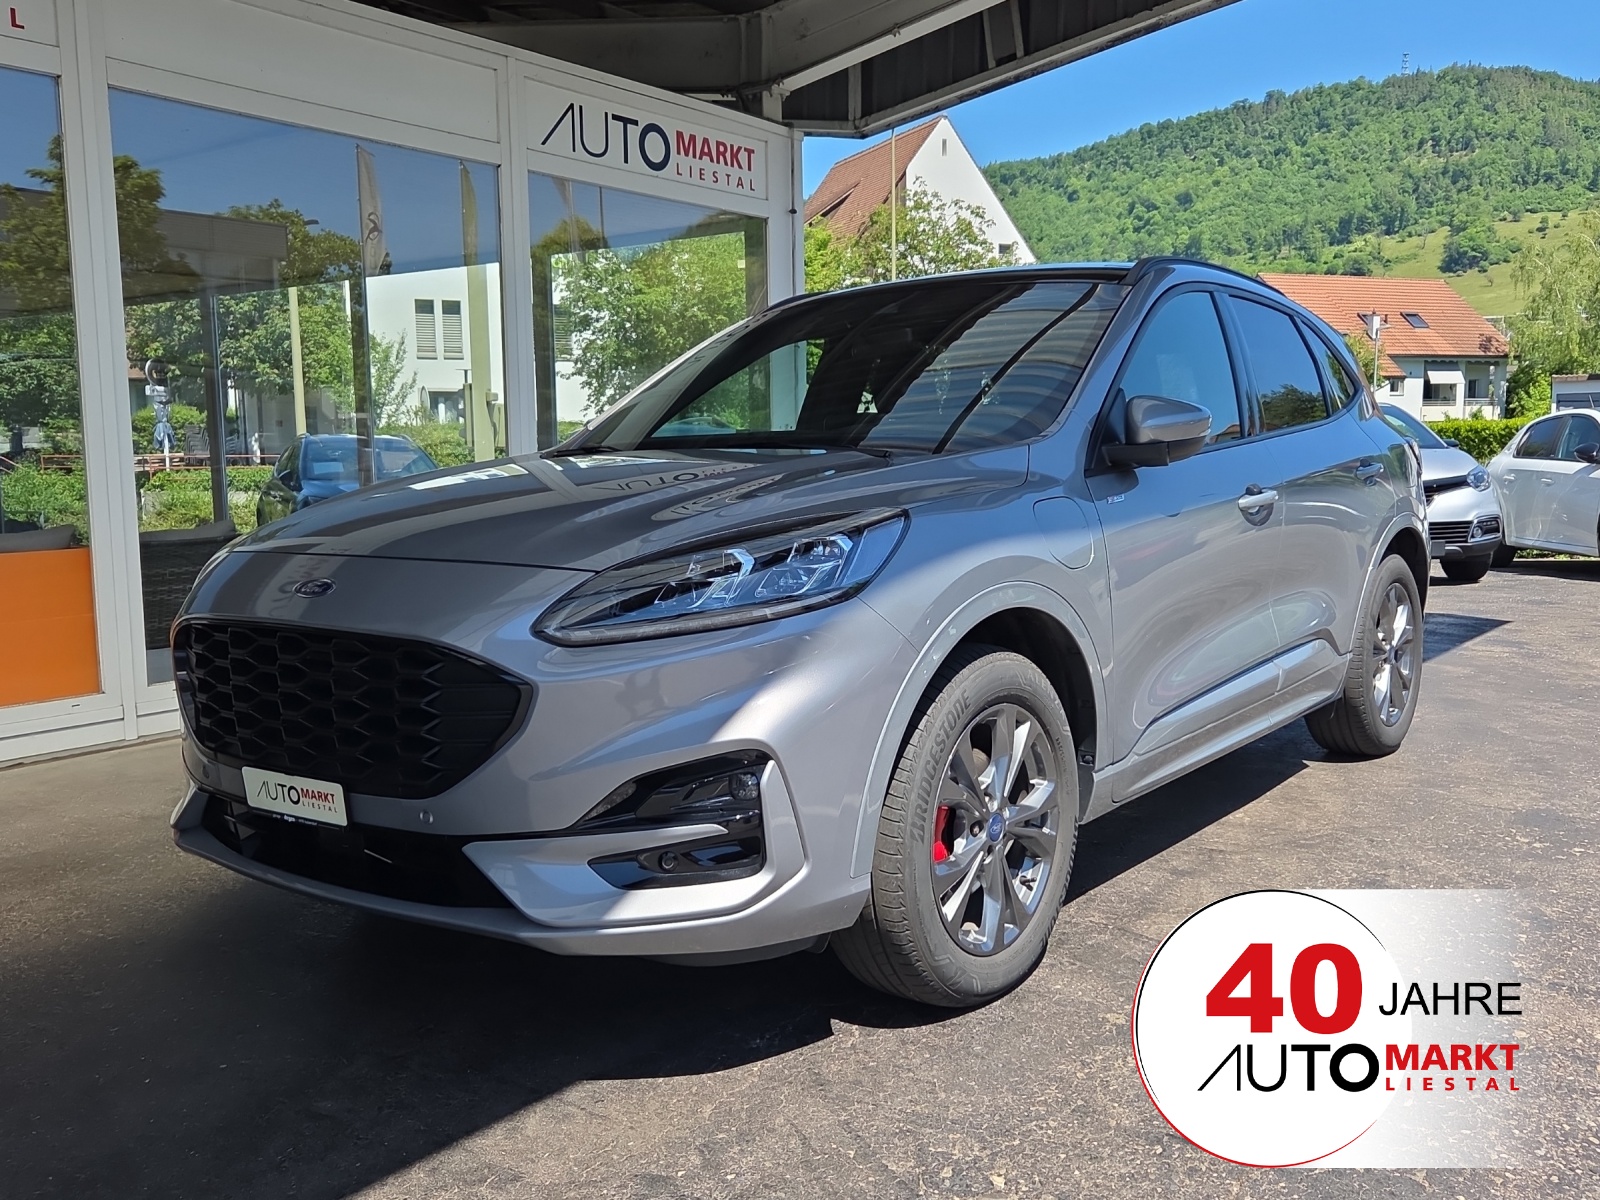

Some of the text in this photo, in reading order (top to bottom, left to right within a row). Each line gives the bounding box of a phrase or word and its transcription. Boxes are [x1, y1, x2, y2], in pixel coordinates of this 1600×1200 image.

[540, 102, 755, 172] AUTO MARKT
[676, 162, 756, 192] LIESTAL
[910, 689, 972, 844] BRIDGESTONE
[257, 780, 335, 806] AUTO MARKT
[302, 801, 338, 814] LIESTAL
